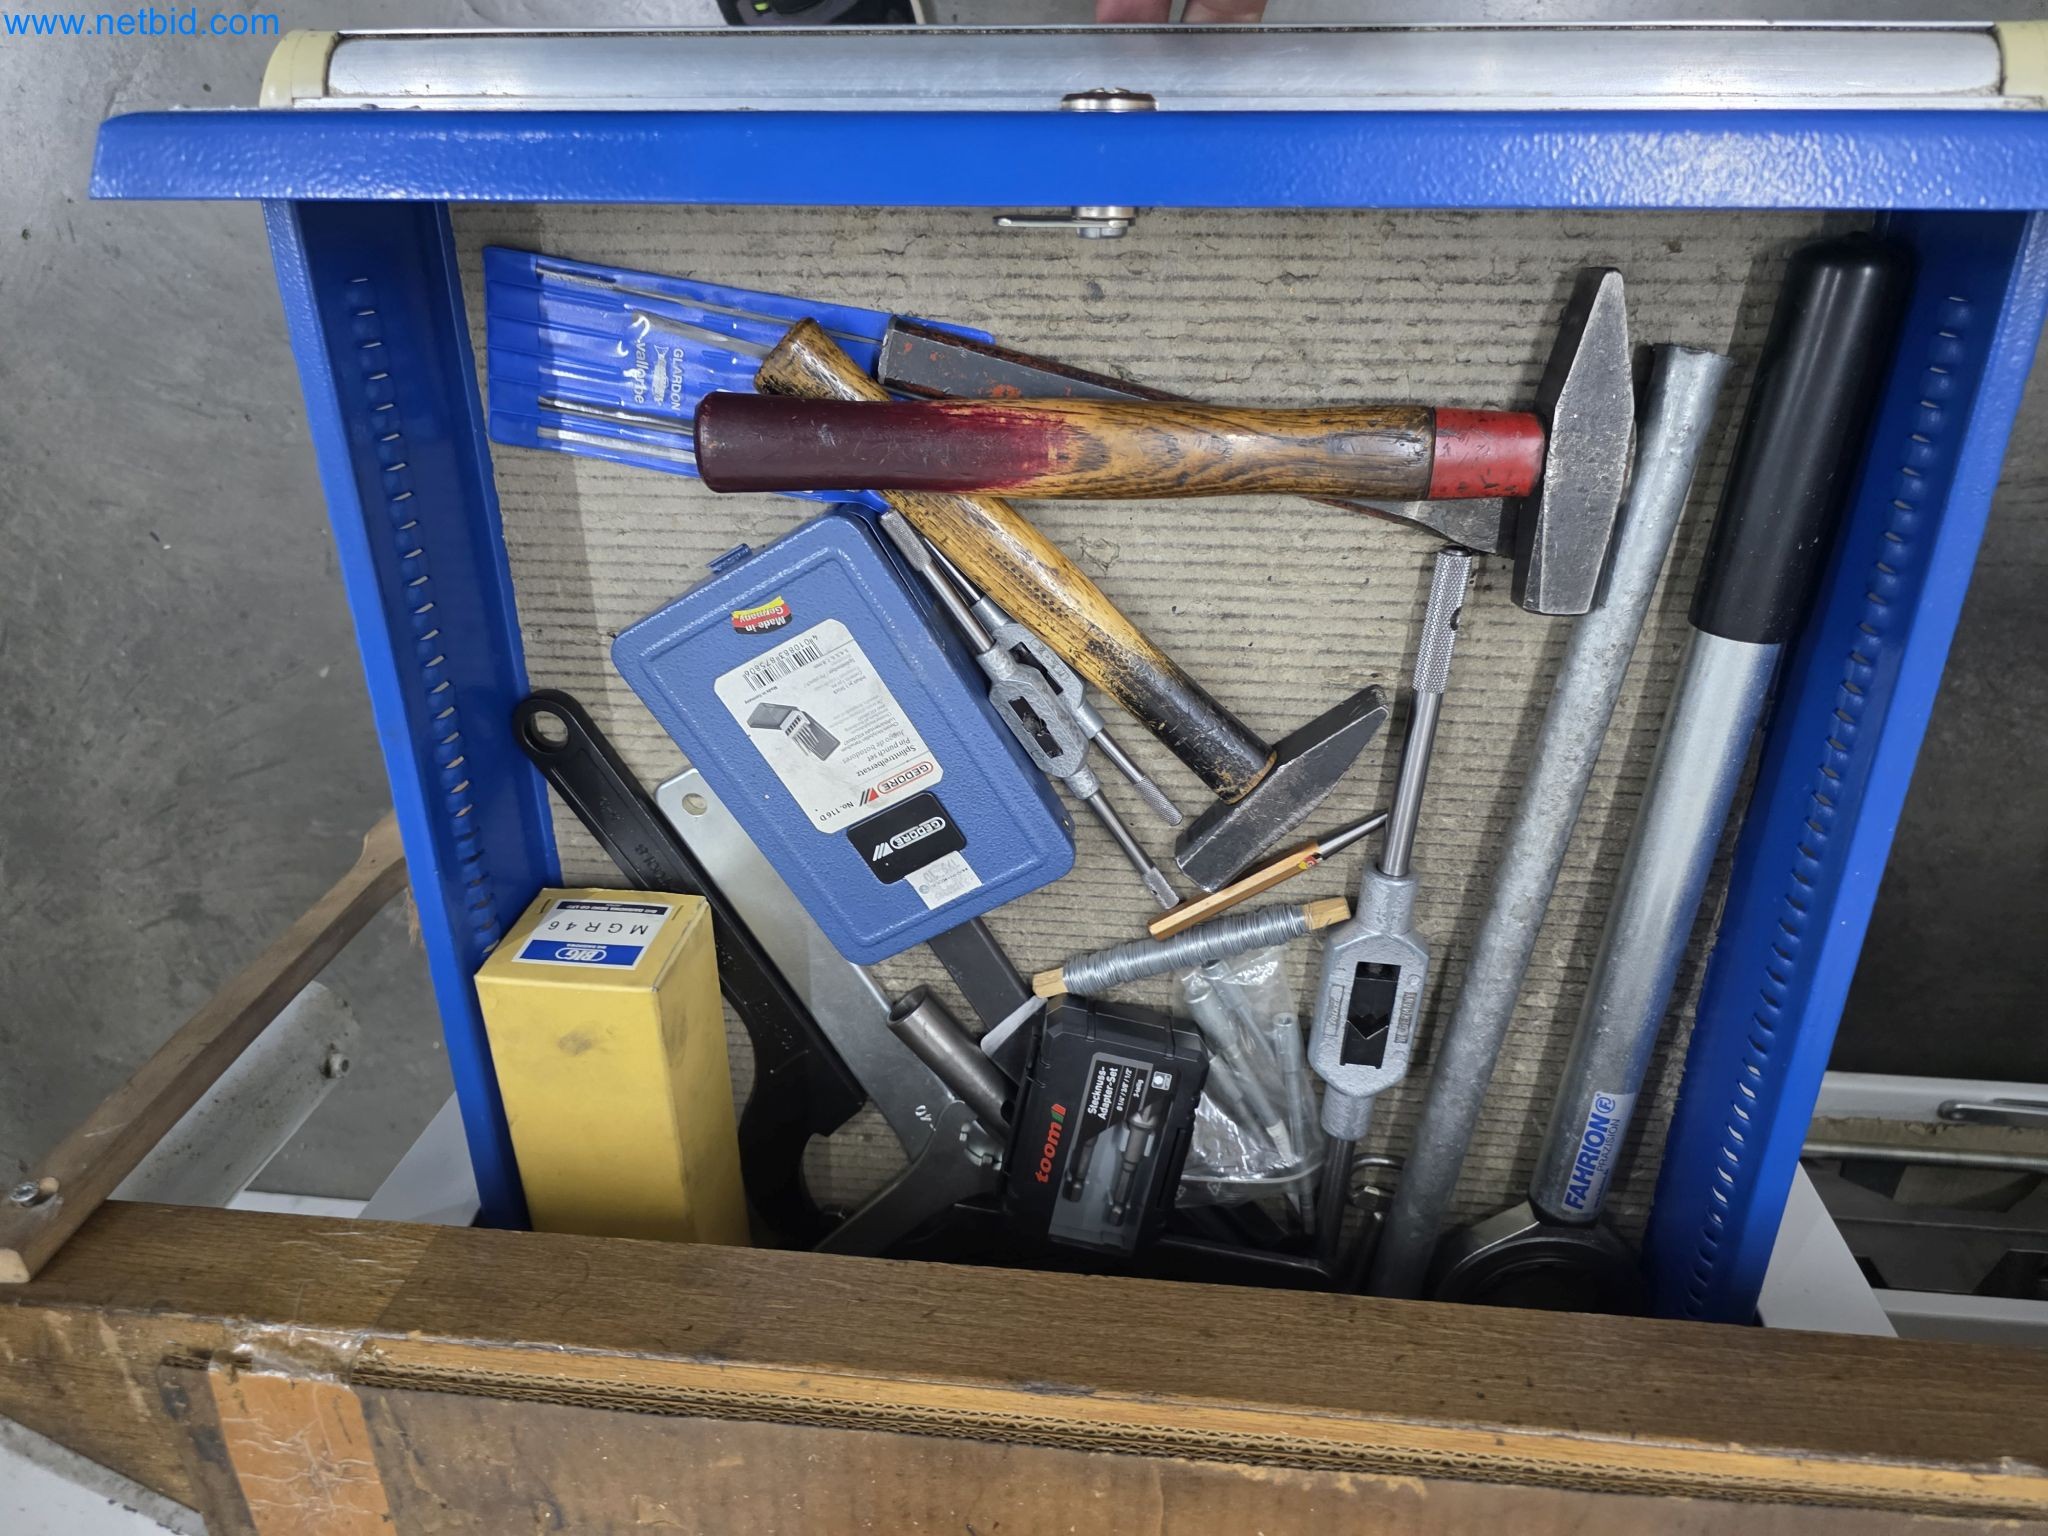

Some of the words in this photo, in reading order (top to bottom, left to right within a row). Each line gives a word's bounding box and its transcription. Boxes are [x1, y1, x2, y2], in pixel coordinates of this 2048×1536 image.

[634, 342, 648, 403] vallorbe
[671, 348, 683, 410] GLARDON
[739, 606, 784, 623] Germany
[757, 615, 785, 629] Made
[746, 624, 756, 632] in
[877, 742, 899, 755] punch
[900, 737, 911, 746] Pin
[857, 744, 916, 777] Splinttreibersatz
[867, 754, 878, 762] set
[882, 764, 929, 791] GEDORE
[825, 807, 840, 818] 116
[840, 801, 854, 810] No.
[894, 819, 940, 846] GEDORE
[564, 949, 597, 961] BIG
[1087, 1066, 1106, 1114] Stecknuss-
[1098, 1067, 1118, 1120] Adapter-Set
[1035, 1121, 1062, 1182] toom
[1564, 1112, 1610, 1210] FAHRION
